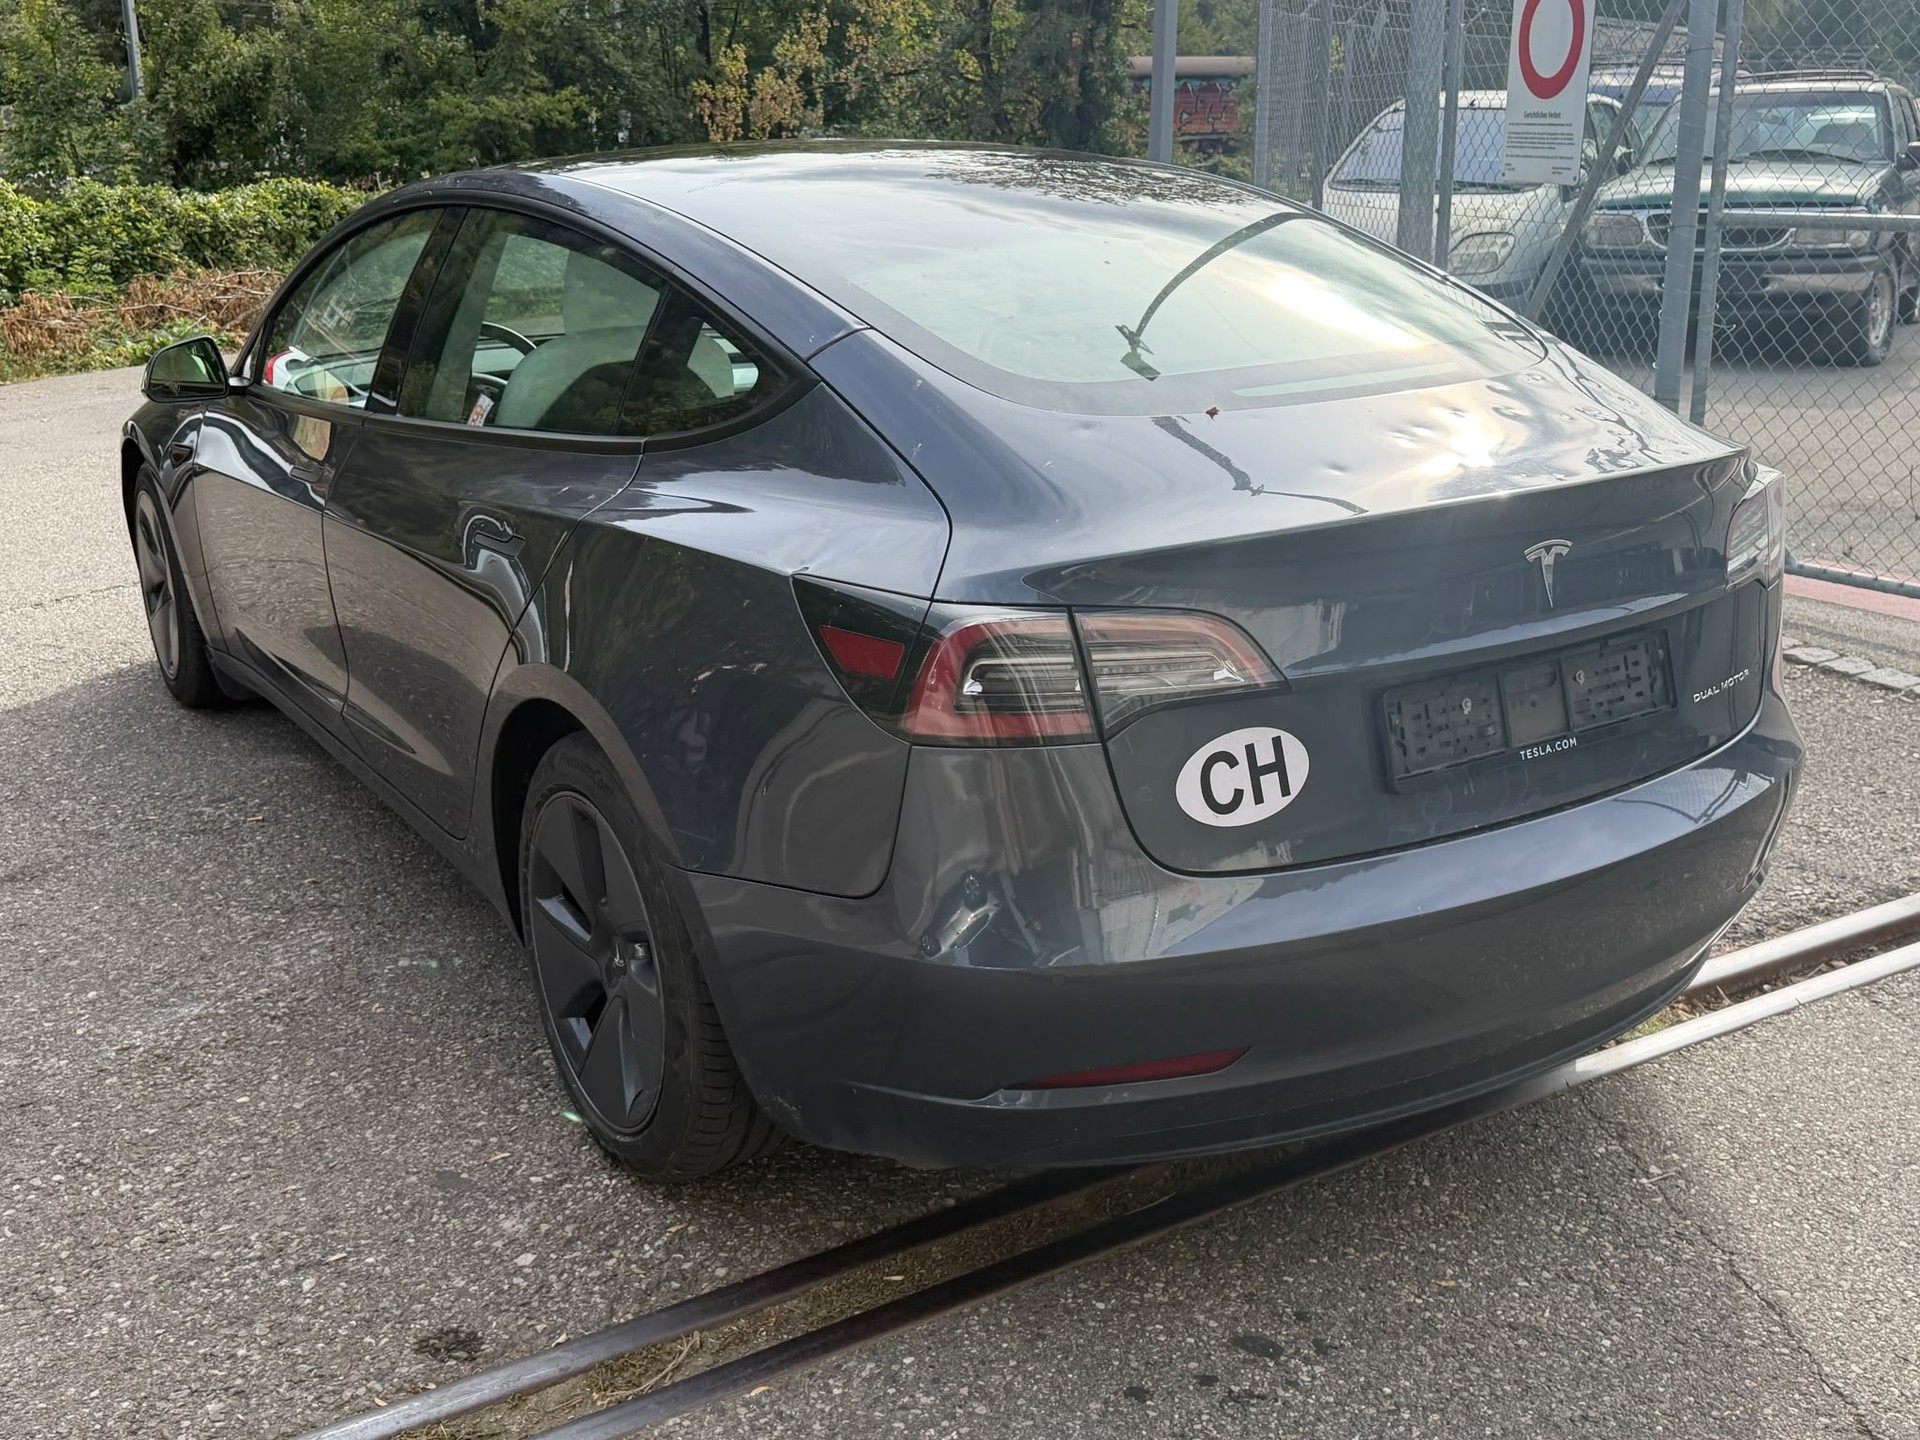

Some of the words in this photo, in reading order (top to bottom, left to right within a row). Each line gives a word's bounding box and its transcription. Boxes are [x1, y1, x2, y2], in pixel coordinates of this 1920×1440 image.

[1693, 686, 1720, 703] DUAL
[1721, 669, 1749, 690] MOTOR
[1520, 737, 1577, 760] TESLA.COM
[1200, 735, 1291, 815] CH
